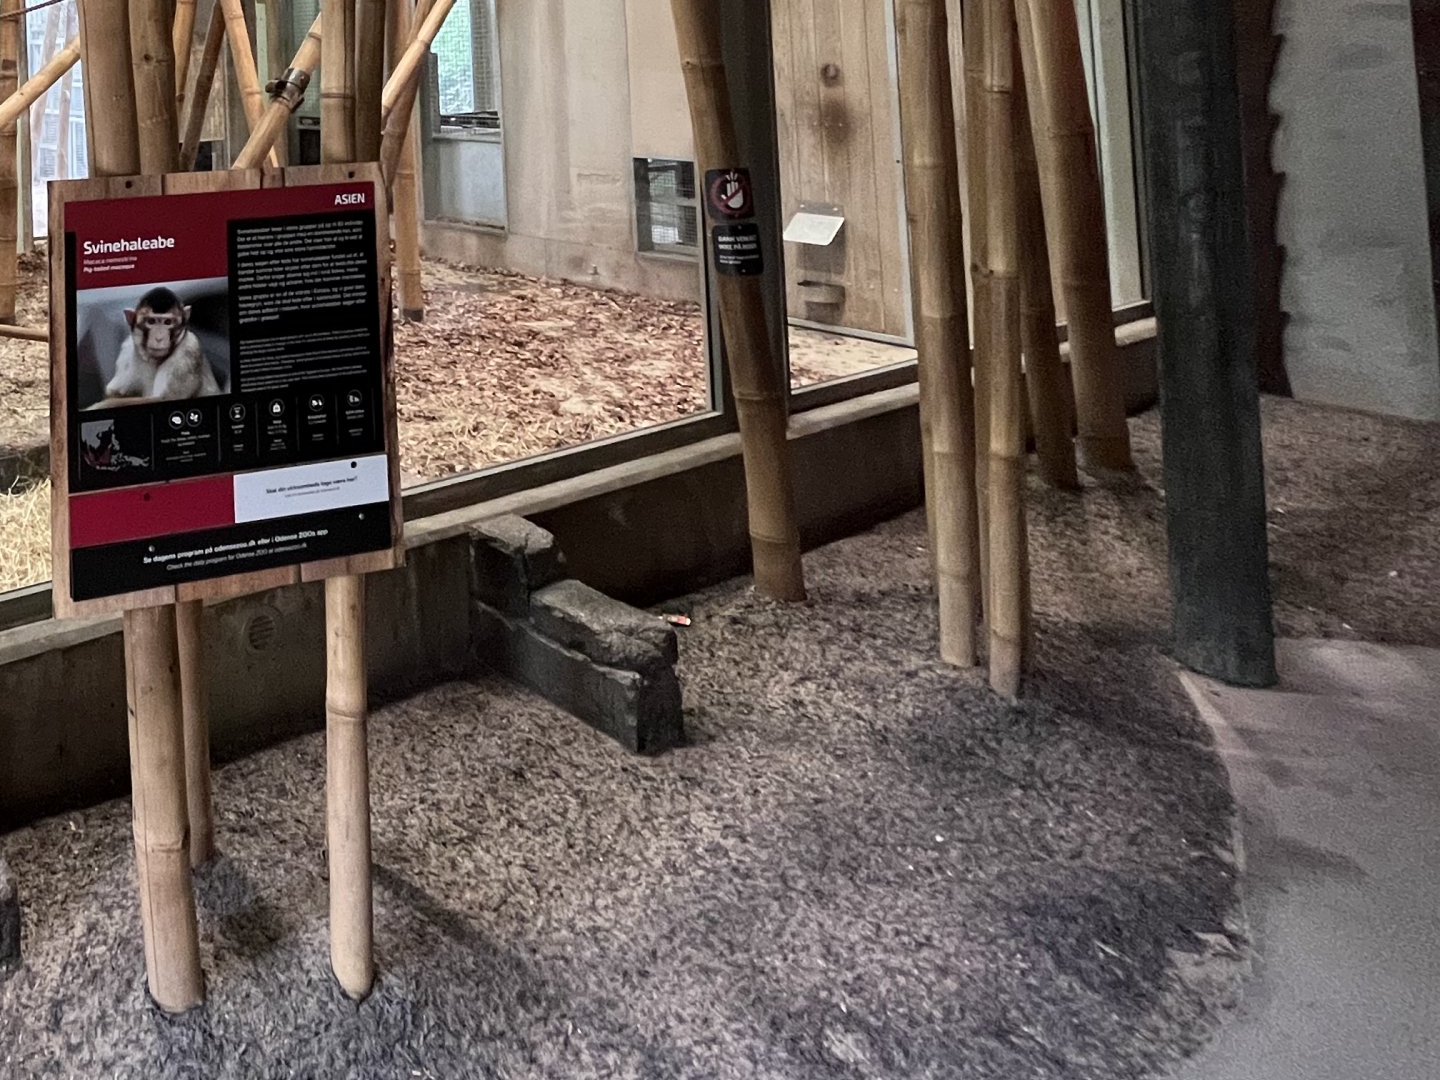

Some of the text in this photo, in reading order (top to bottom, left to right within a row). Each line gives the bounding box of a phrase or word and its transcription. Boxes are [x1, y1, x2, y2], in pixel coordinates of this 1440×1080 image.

[334, 193, 365, 206] ASIEN
[83, 236, 175, 255] Svinehaleabe
[143, 556, 152, 564] Se
[153, 553, 176, 563] dagens
[177, 549, 204, 559] program
[205, 546, 213, 555] på
[274, 533, 298, 543] Odense
